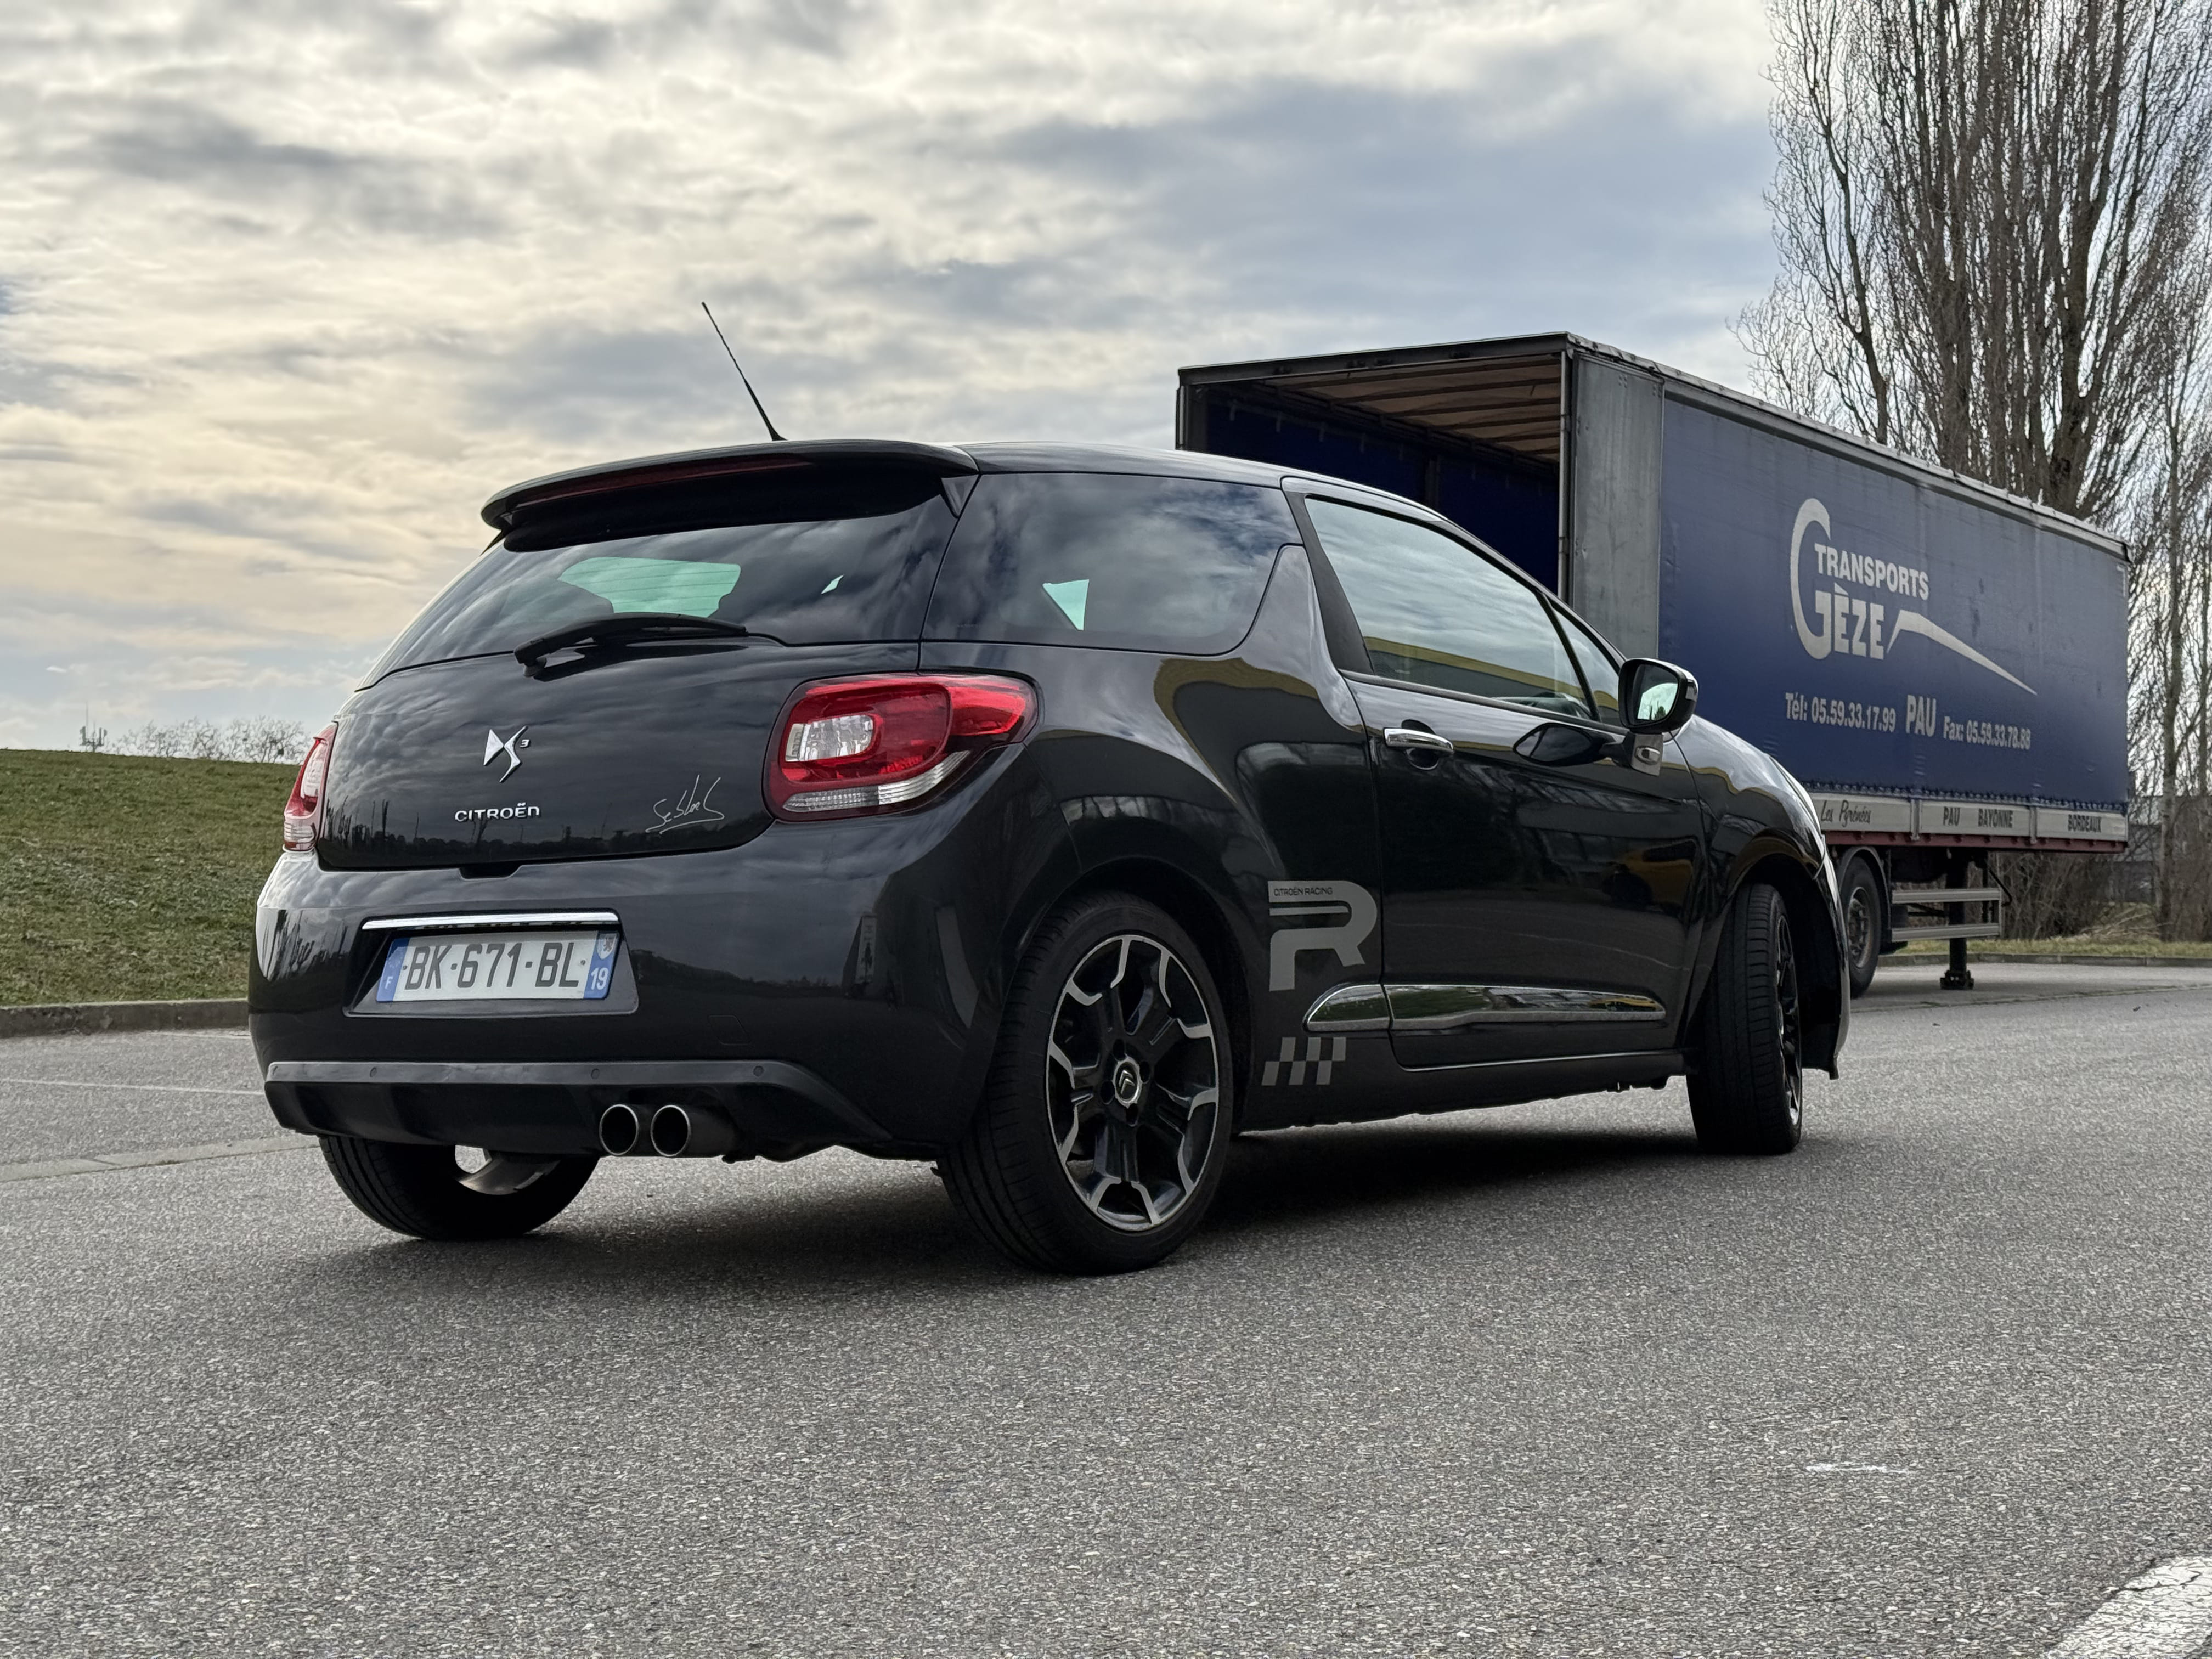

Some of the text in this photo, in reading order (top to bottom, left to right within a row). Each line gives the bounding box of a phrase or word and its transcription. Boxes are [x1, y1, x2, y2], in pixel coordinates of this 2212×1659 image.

[1790, 498, 1884, 660] GÈZE
[1814, 543, 1929, 600] TRANSPORTS
[1786, 692, 1807, 721] Tél:
[1812, 697, 1896, 732] 05.59.33.17.99
[1906, 695, 1937, 737] PAU
[1943, 716, 1964, 741] Fax:
[1821, 800, 1871, 827] Les Pyrénées
[1943, 806, 1960, 826] PAU
[1978, 808, 2013, 828] BAYONNE
[2068, 814, 2102, 833] BORDEAUX
[385, 975, 393, 989] F
[591, 966, 608, 990] 19
